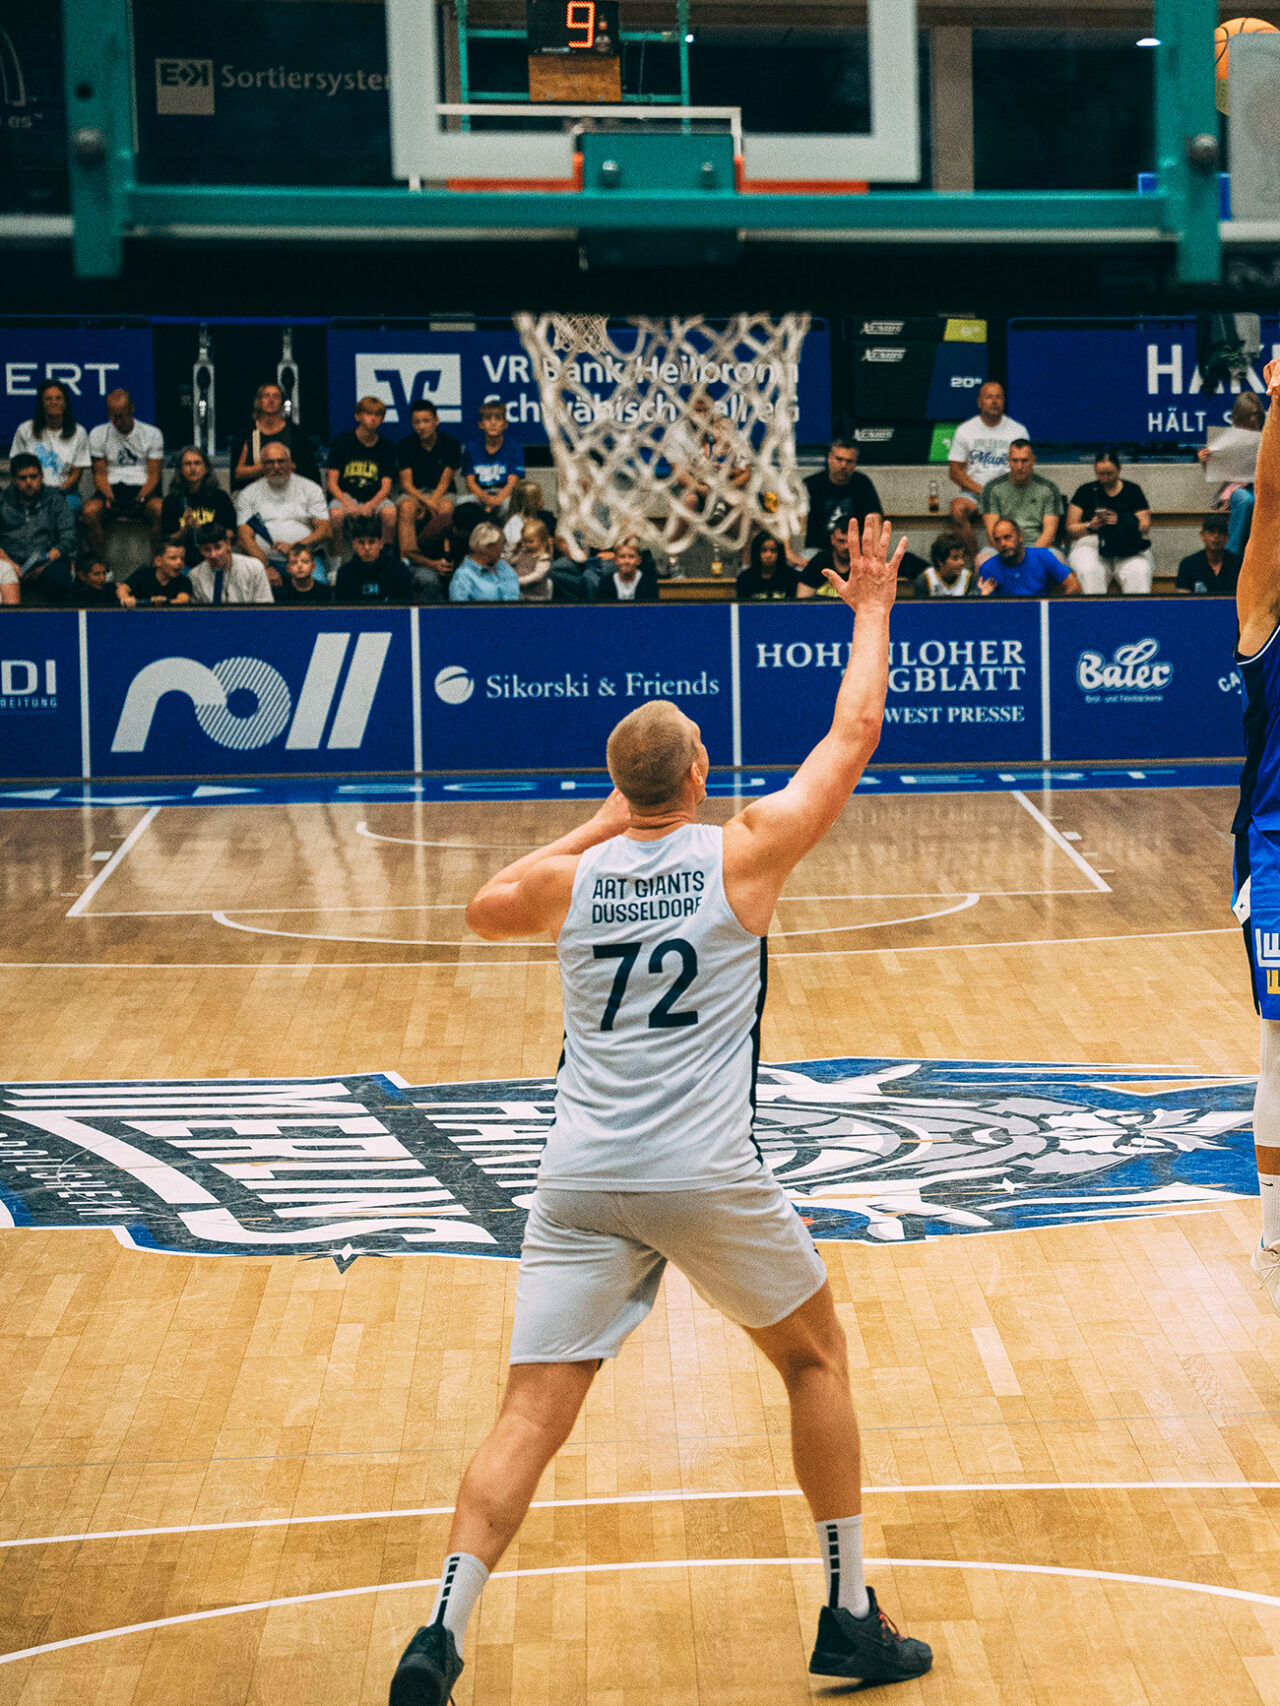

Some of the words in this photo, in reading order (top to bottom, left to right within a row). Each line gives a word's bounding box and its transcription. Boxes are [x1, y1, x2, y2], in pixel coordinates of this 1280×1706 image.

[566, 0, 596, 49] 9
[482, 354, 530, 384] VR
[1148, 405, 1206, 433] HÄLT
[756, 640, 1026, 669] HOHLOHER
[486, 673, 590, 699] Sikorski
[597, 675, 617, 698] &
[626, 671, 720, 698] Friends
[883, 706, 943, 725] WEST
[947, 705, 1025, 724] PRESSE
[592, 878, 628, 900] ART
[635, 870, 705, 899] GIANTS
[592, 937, 699, 1032] 72
[0, 1081, 499, 1245] MERLINS
[0, 1132, 143, 1217] RAILSHEIM
